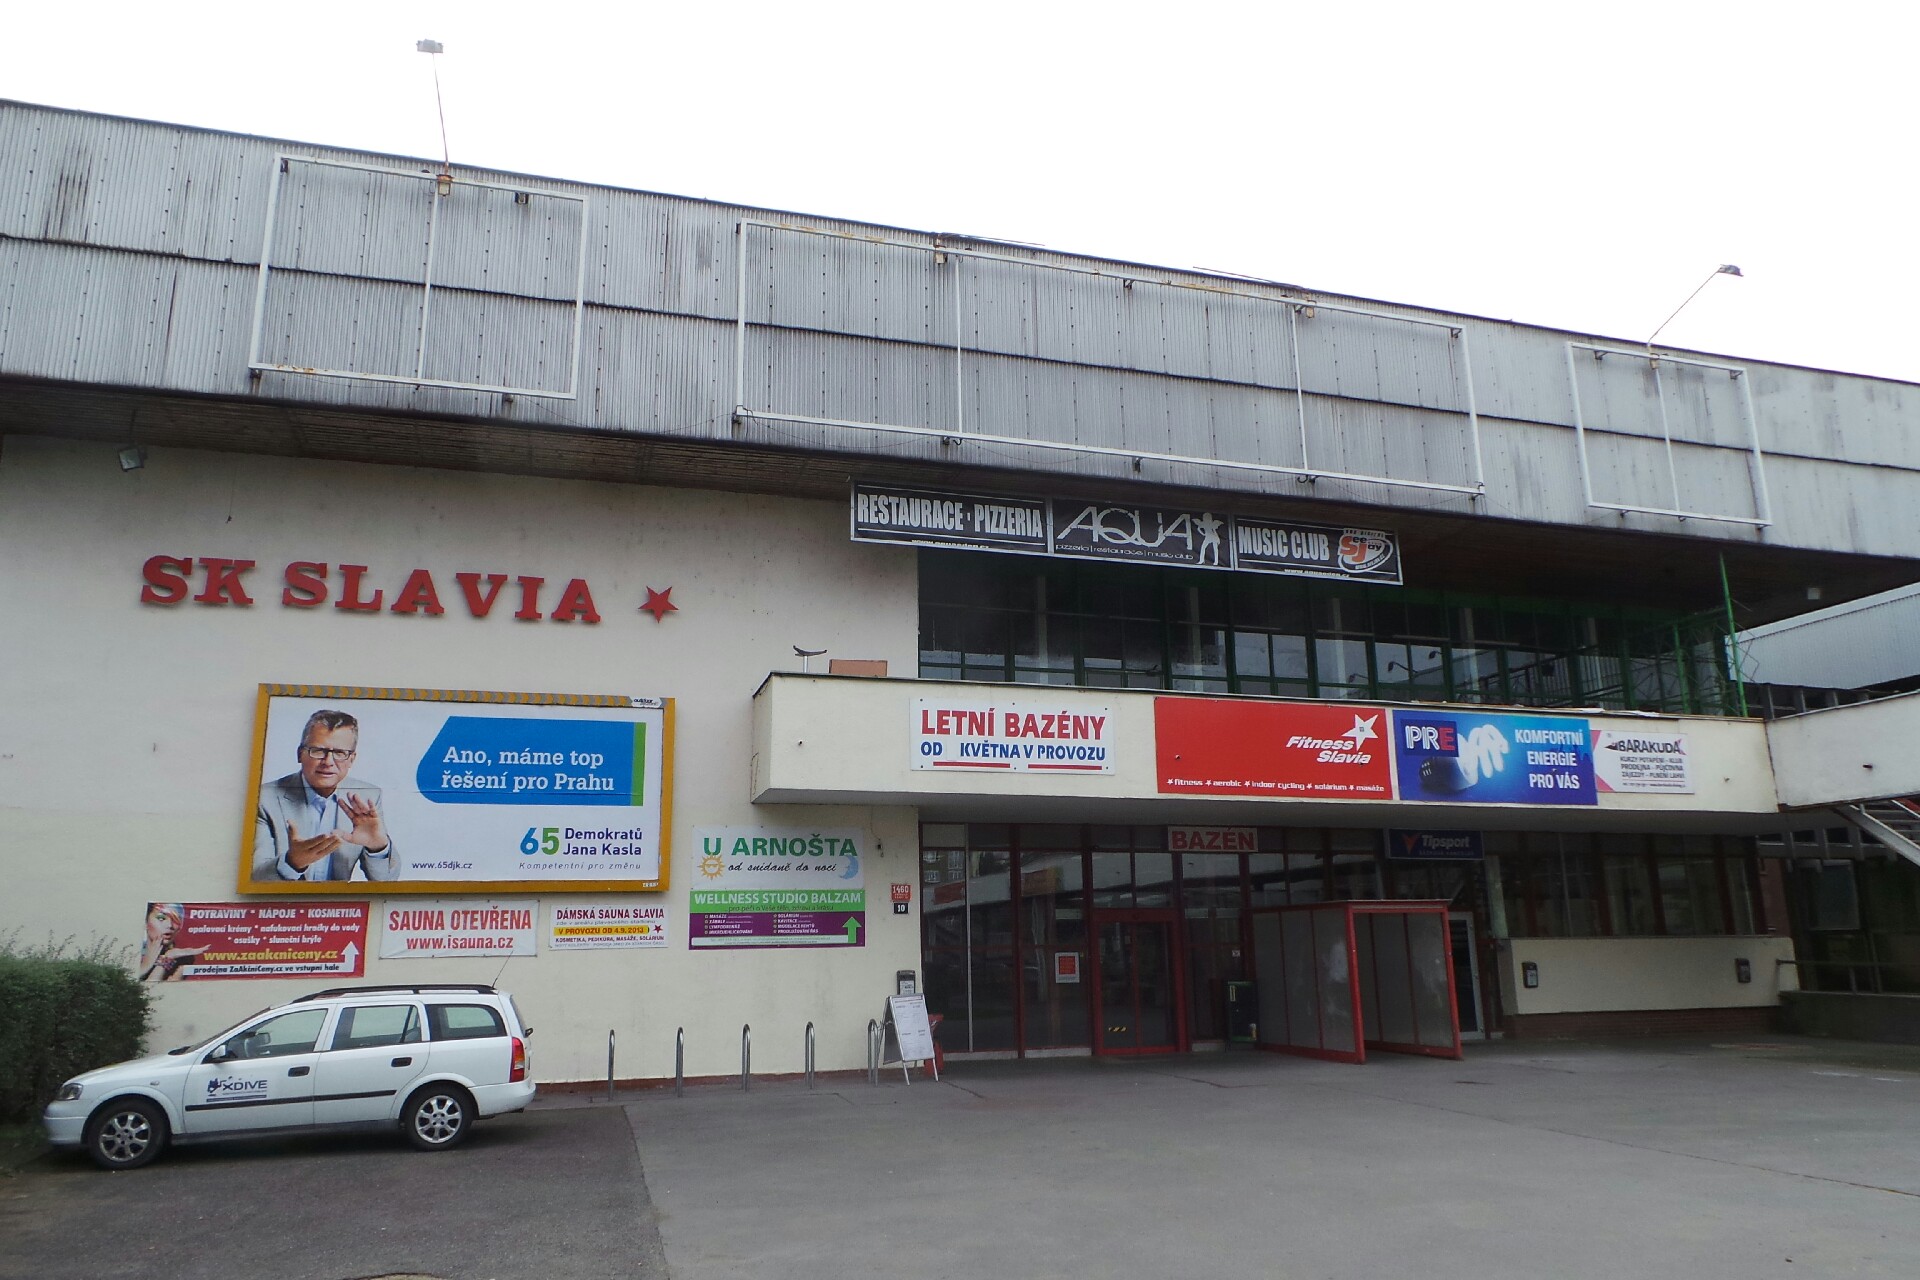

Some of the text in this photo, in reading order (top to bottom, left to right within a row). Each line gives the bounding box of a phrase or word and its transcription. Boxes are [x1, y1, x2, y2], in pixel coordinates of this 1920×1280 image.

[857, 493, 1043, 538] RESTAURACE PIZZERIA
[1056, 506, 1193, 550] AQUA
[1237, 525, 1288, 558] MUSIC
[1291, 531, 1330, 561] CLUB
[140, 555, 601, 623] SK SLAVIA
[921, 707, 1106, 740] LETNÍ BAZÉNY
[1285, 736, 1355, 750] Fitness
[1405, 725, 1456, 751] PRE
[1515, 729, 1584, 746] KOMFORTNÍ
[920, 740, 1106, 761] OD KVĚTNA V PROVOZU
[1618, 739, 1681, 753] BARAKUDA
[442, 746, 604, 769] Ano, máme top
[1316, 751, 1372, 764] Slavia
[1527, 750, 1578, 767] ENERGIE
[441, 770, 615, 793] řešení pro Prahu
[1174, 778, 1203, 786] fitness
[1212, 779, 1242, 787] aerobic
[1251, 780, 1276, 789] indoor
[1277, 781, 1305, 791] cycling
[1529, 771, 1580, 790] PRO VÁS
[519, 827, 643, 856] 65 Demokratů
[703, 833, 858, 857] U ARNOŠTA
[1171, 826, 1255, 850] BAZÉN
[1421, 834, 1470, 849] Tipsport
[563, 843, 642, 856] Jana Kasla
[411, 861, 473, 871] www.65djk.cz
[518, 861, 642, 871] Kompetentní pro změnu
[728, 862, 743, 872] od
[747, 862, 792, 872] snídaně
[795, 862, 809, 872] do
[892, 885, 909, 893] 1460
[694, 891, 861, 904] WELLNESS STUDIO BALZAM
[190, 907, 362, 919] POTRAVINY NÁPOJE KOSMETIKA
[556, 906, 665, 920] DÁMSKÁ SAUNA SLAVIA
[897, 904, 906, 912] 10
[388, 905, 531, 931] SAUNA OTEVŘENA
[406, 934, 514, 950] www.isauna.cz
[193, 964, 228, 974] prodejna
[324, 963, 340, 971] hale
